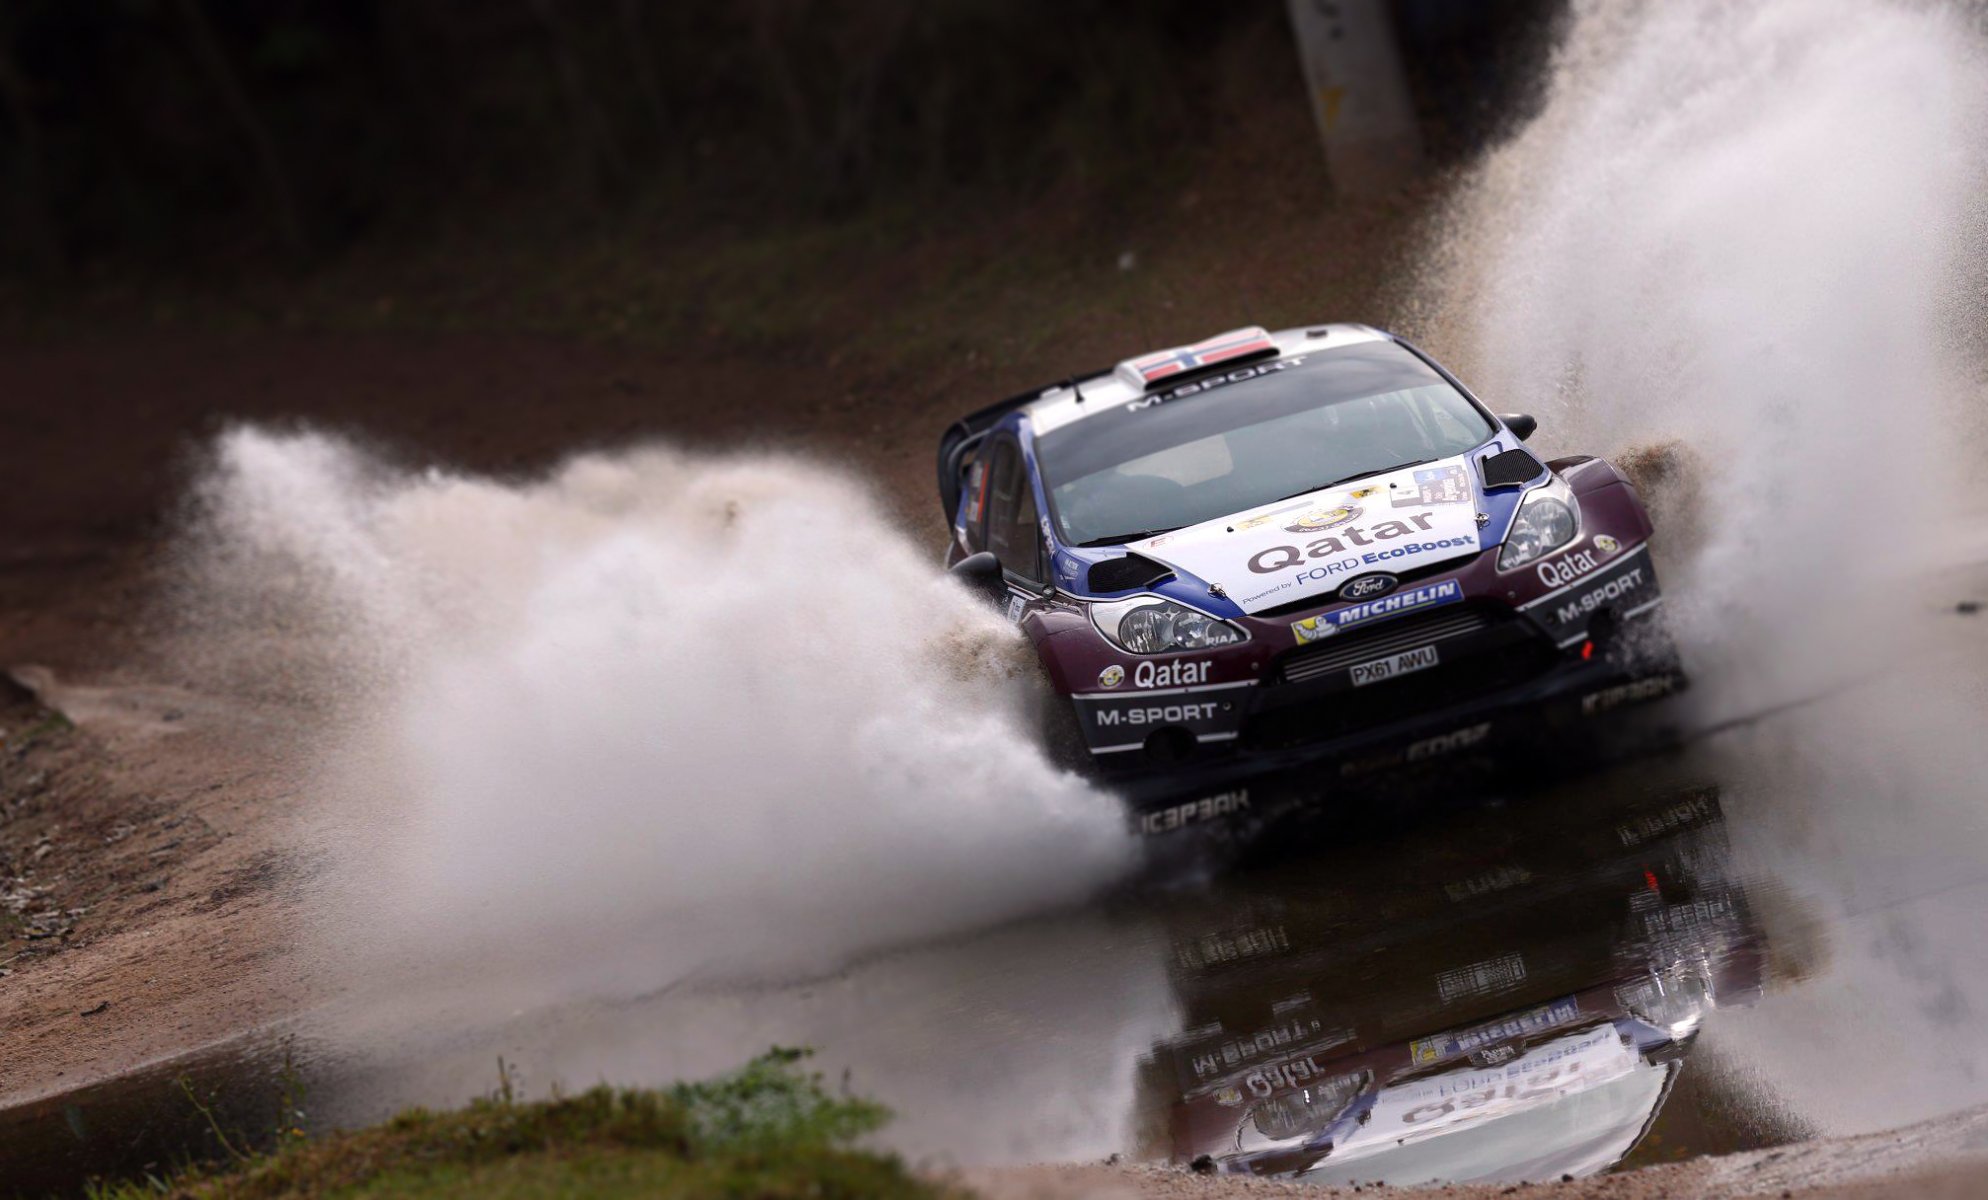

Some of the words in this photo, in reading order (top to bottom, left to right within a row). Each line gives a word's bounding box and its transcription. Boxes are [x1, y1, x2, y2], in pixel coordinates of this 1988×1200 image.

[1248, 511, 1434, 575] Qatar
[1243, 585, 1280, 604] Powered
[1281, 581, 1292, 589] by
[1295, 558, 1360, 585] FORD
[1361, 534, 1476, 564] EcoBoost
[1352, 578, 1385, 597] Ford
[1537, 548, 1599, 588] Qatar
[1338, 582, 1456, 625] MICHELIN
[1557, 568, 1643, 623] M-SPORT
[1134, 658, 1212, 688] Qatar
[1352, 659, 1393, 684] PX61
[1397, 647, 1437, 672] AWU
[1097, 702, 1218, 726] M-SPORT
